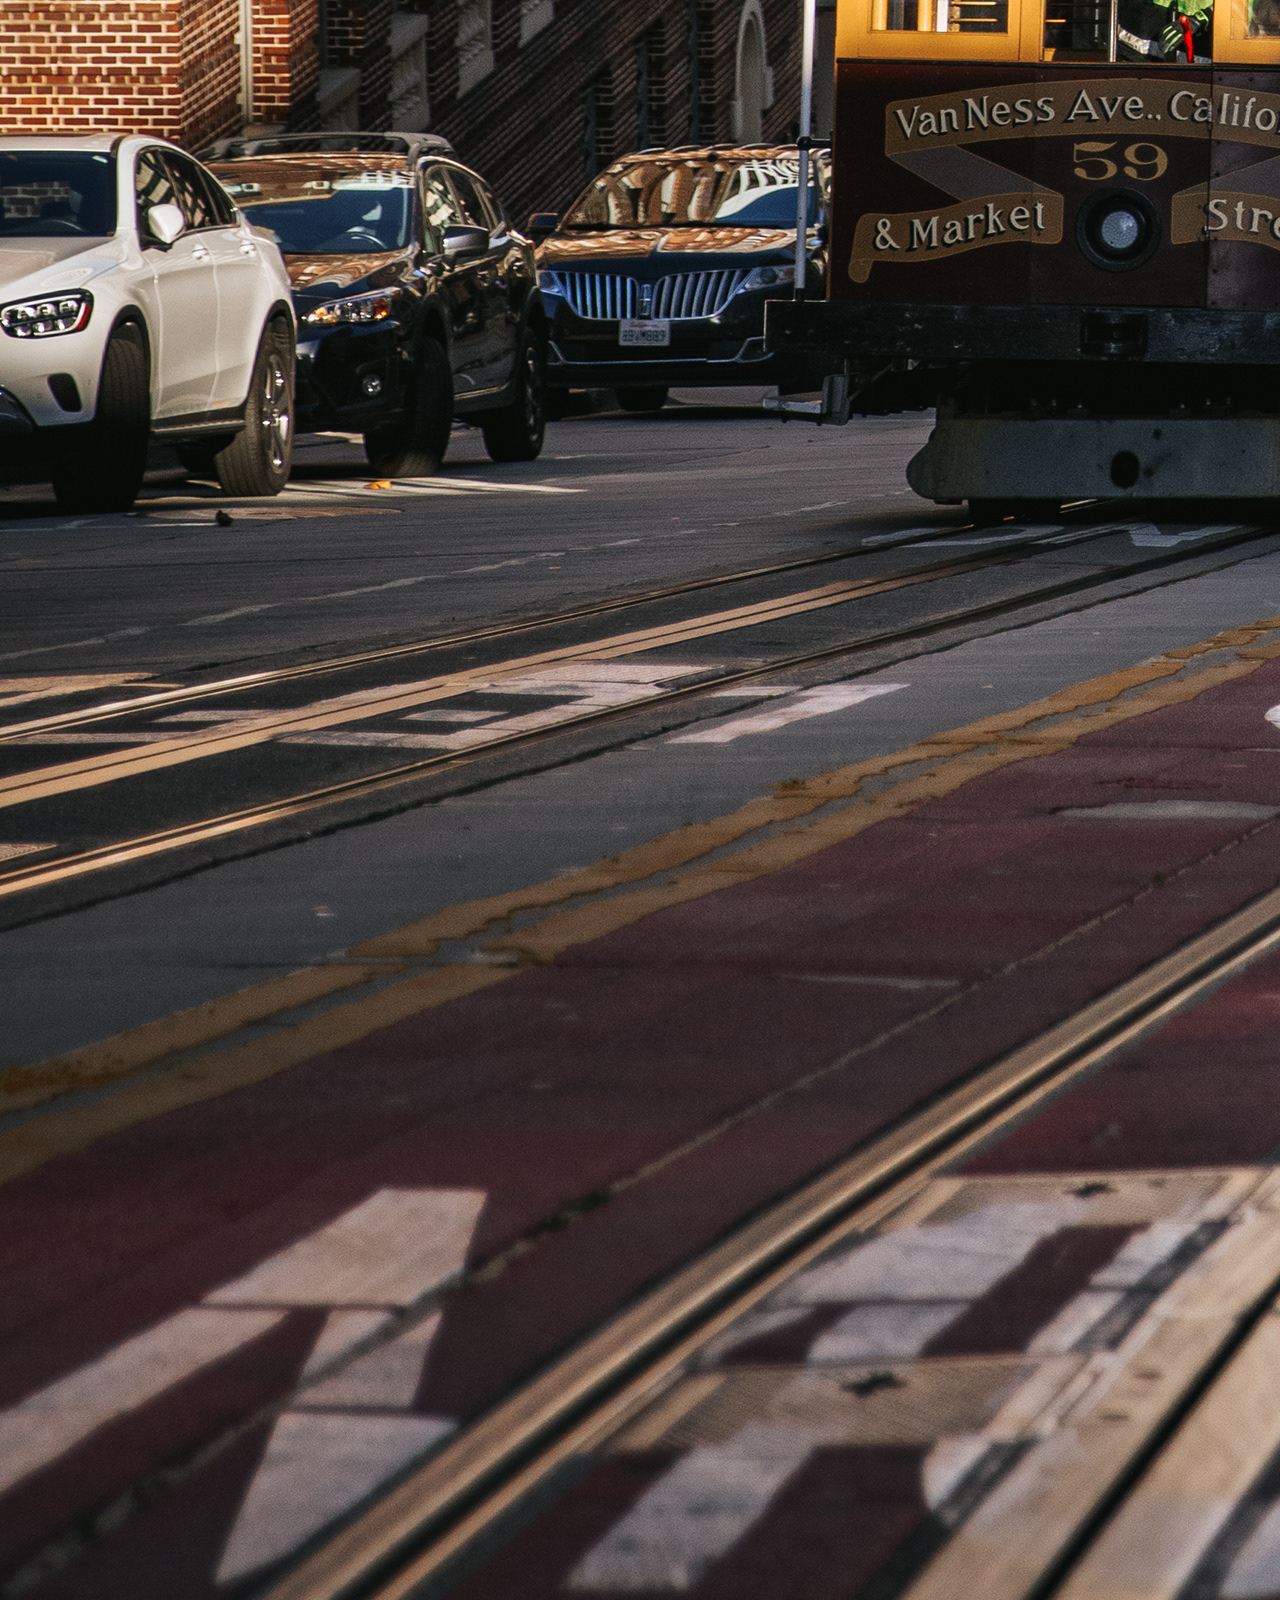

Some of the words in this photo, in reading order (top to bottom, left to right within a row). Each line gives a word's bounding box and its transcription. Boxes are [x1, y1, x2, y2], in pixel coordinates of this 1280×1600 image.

[895, 104, 960, 139] Van
[963, 95, 1055, 130] Ness
[1073, 141, 1169, 181] 59
[873, 218, 900, 250] &
[910, 201, 1046, 249] Market
